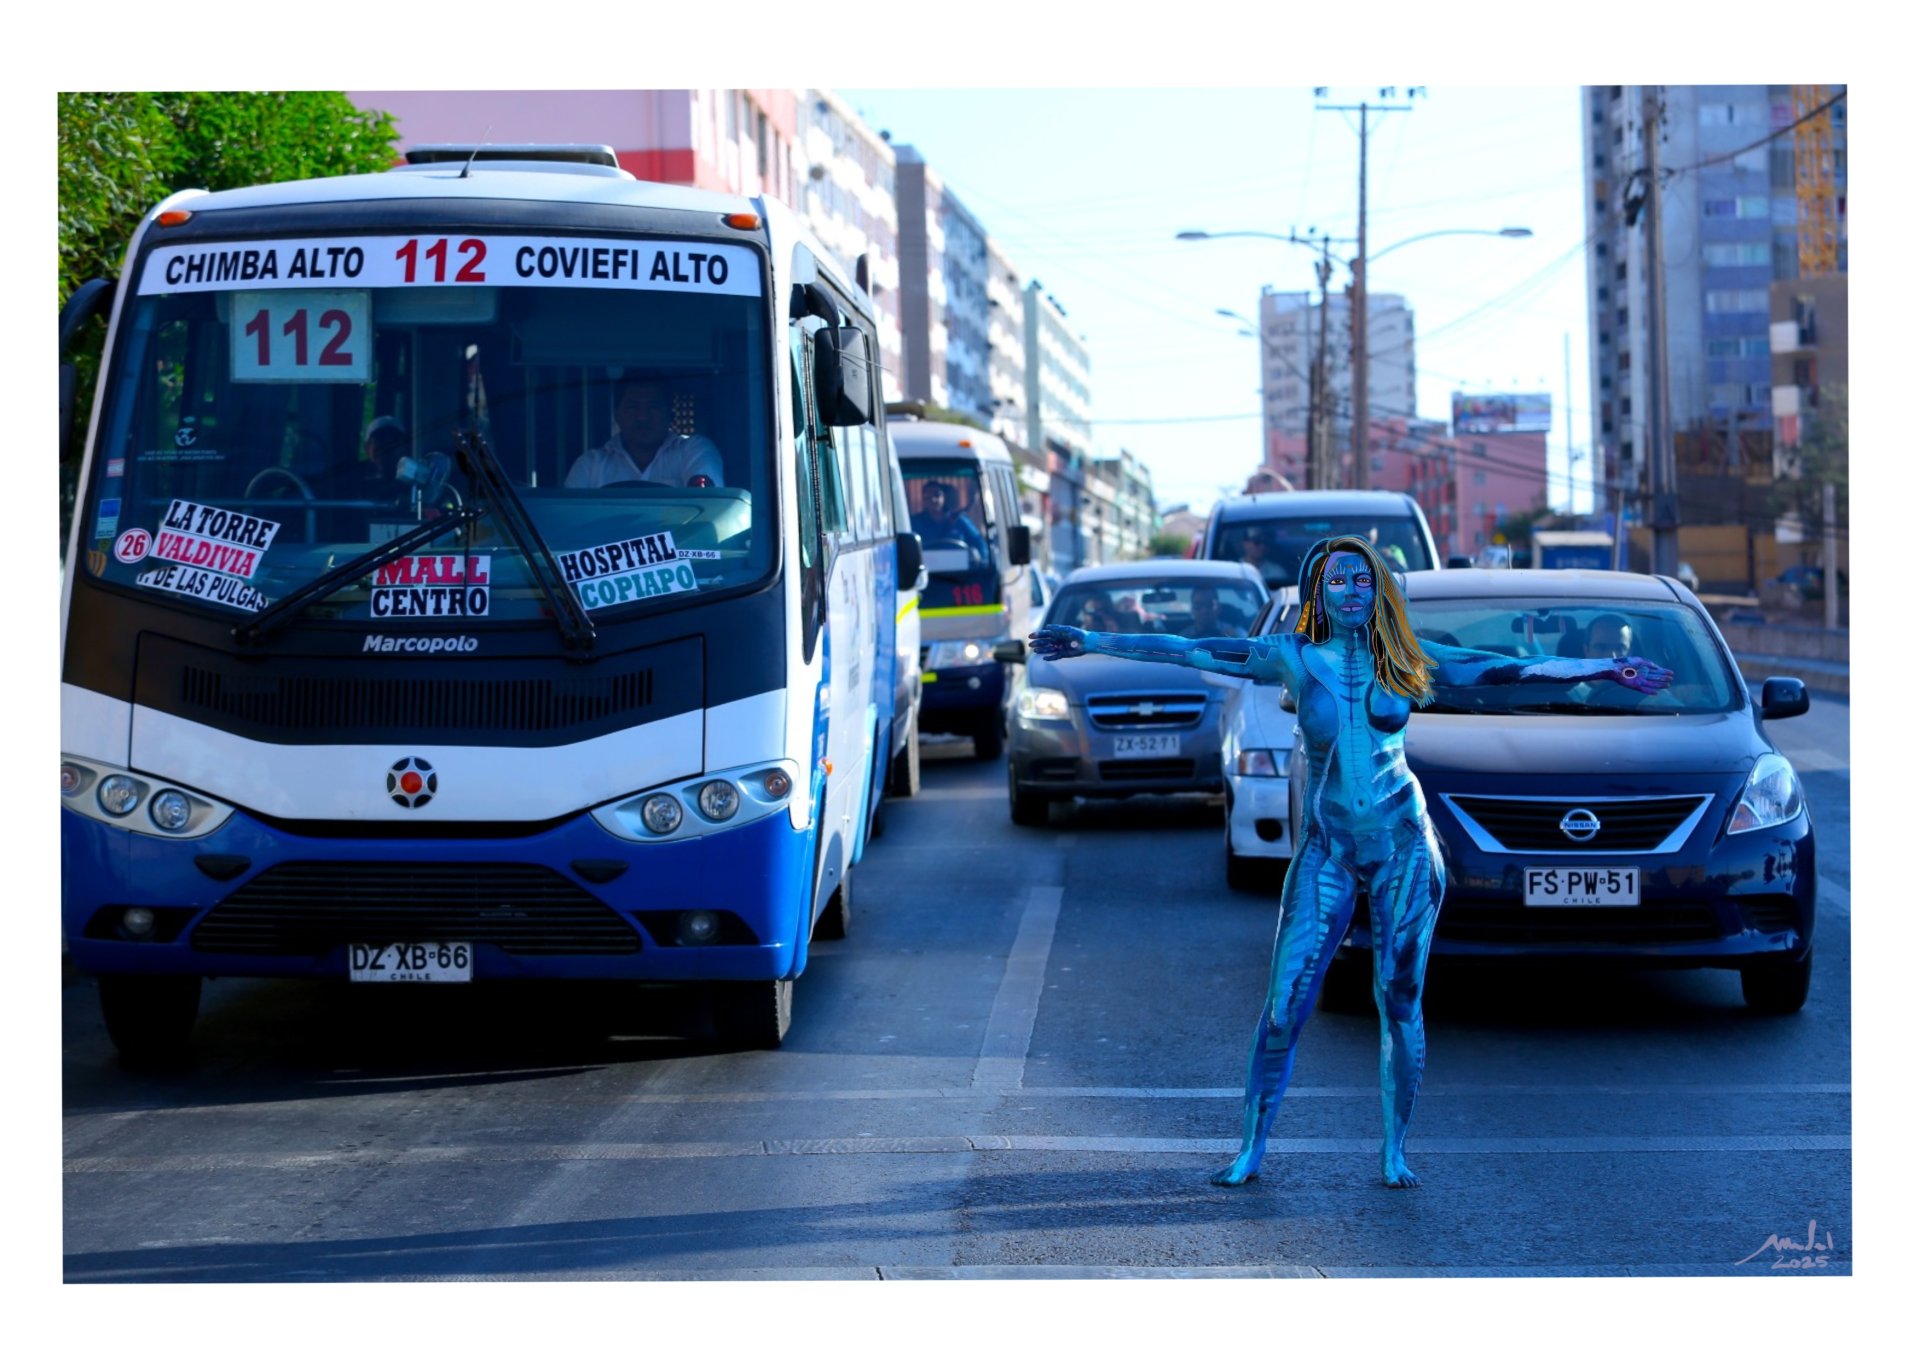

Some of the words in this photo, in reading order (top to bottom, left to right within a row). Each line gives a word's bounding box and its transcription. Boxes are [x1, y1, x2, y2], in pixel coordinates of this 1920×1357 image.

[165, 249, 279, 286] CHIMBA
[288, 246, 365, 279] ALTO
[395, 238, 488, 283] 112
[515, 246, 639, 280] COVIEFI
[649, 250, 729, 286] ALTO
[245, 308, 354, 366] 112
[165, 501, 198, 532] LA
[195, 507, 274, 549] TORRE
[121, 534, 147, 557] 26
[155, 532, 257, 577] VALDIVIA
[560, 533, 677, 582] HOSPITAL
[153, 566, 178, 588] DE
[175, 570, 207, 595] LAS
[207, 573, 268, 613] PULGAS
[377, 556, 488, 586] MALL
[580, 564, 695, 609] COPIAPO
[372, 587, 488, 617] CENTRO
[952, 583, 983, 606] 116
[362, 634, 479, 654] Marcopolo
[1563, 821, 1599, 830] NISSAN
[1563, 897, 1601, 905] CHILE
